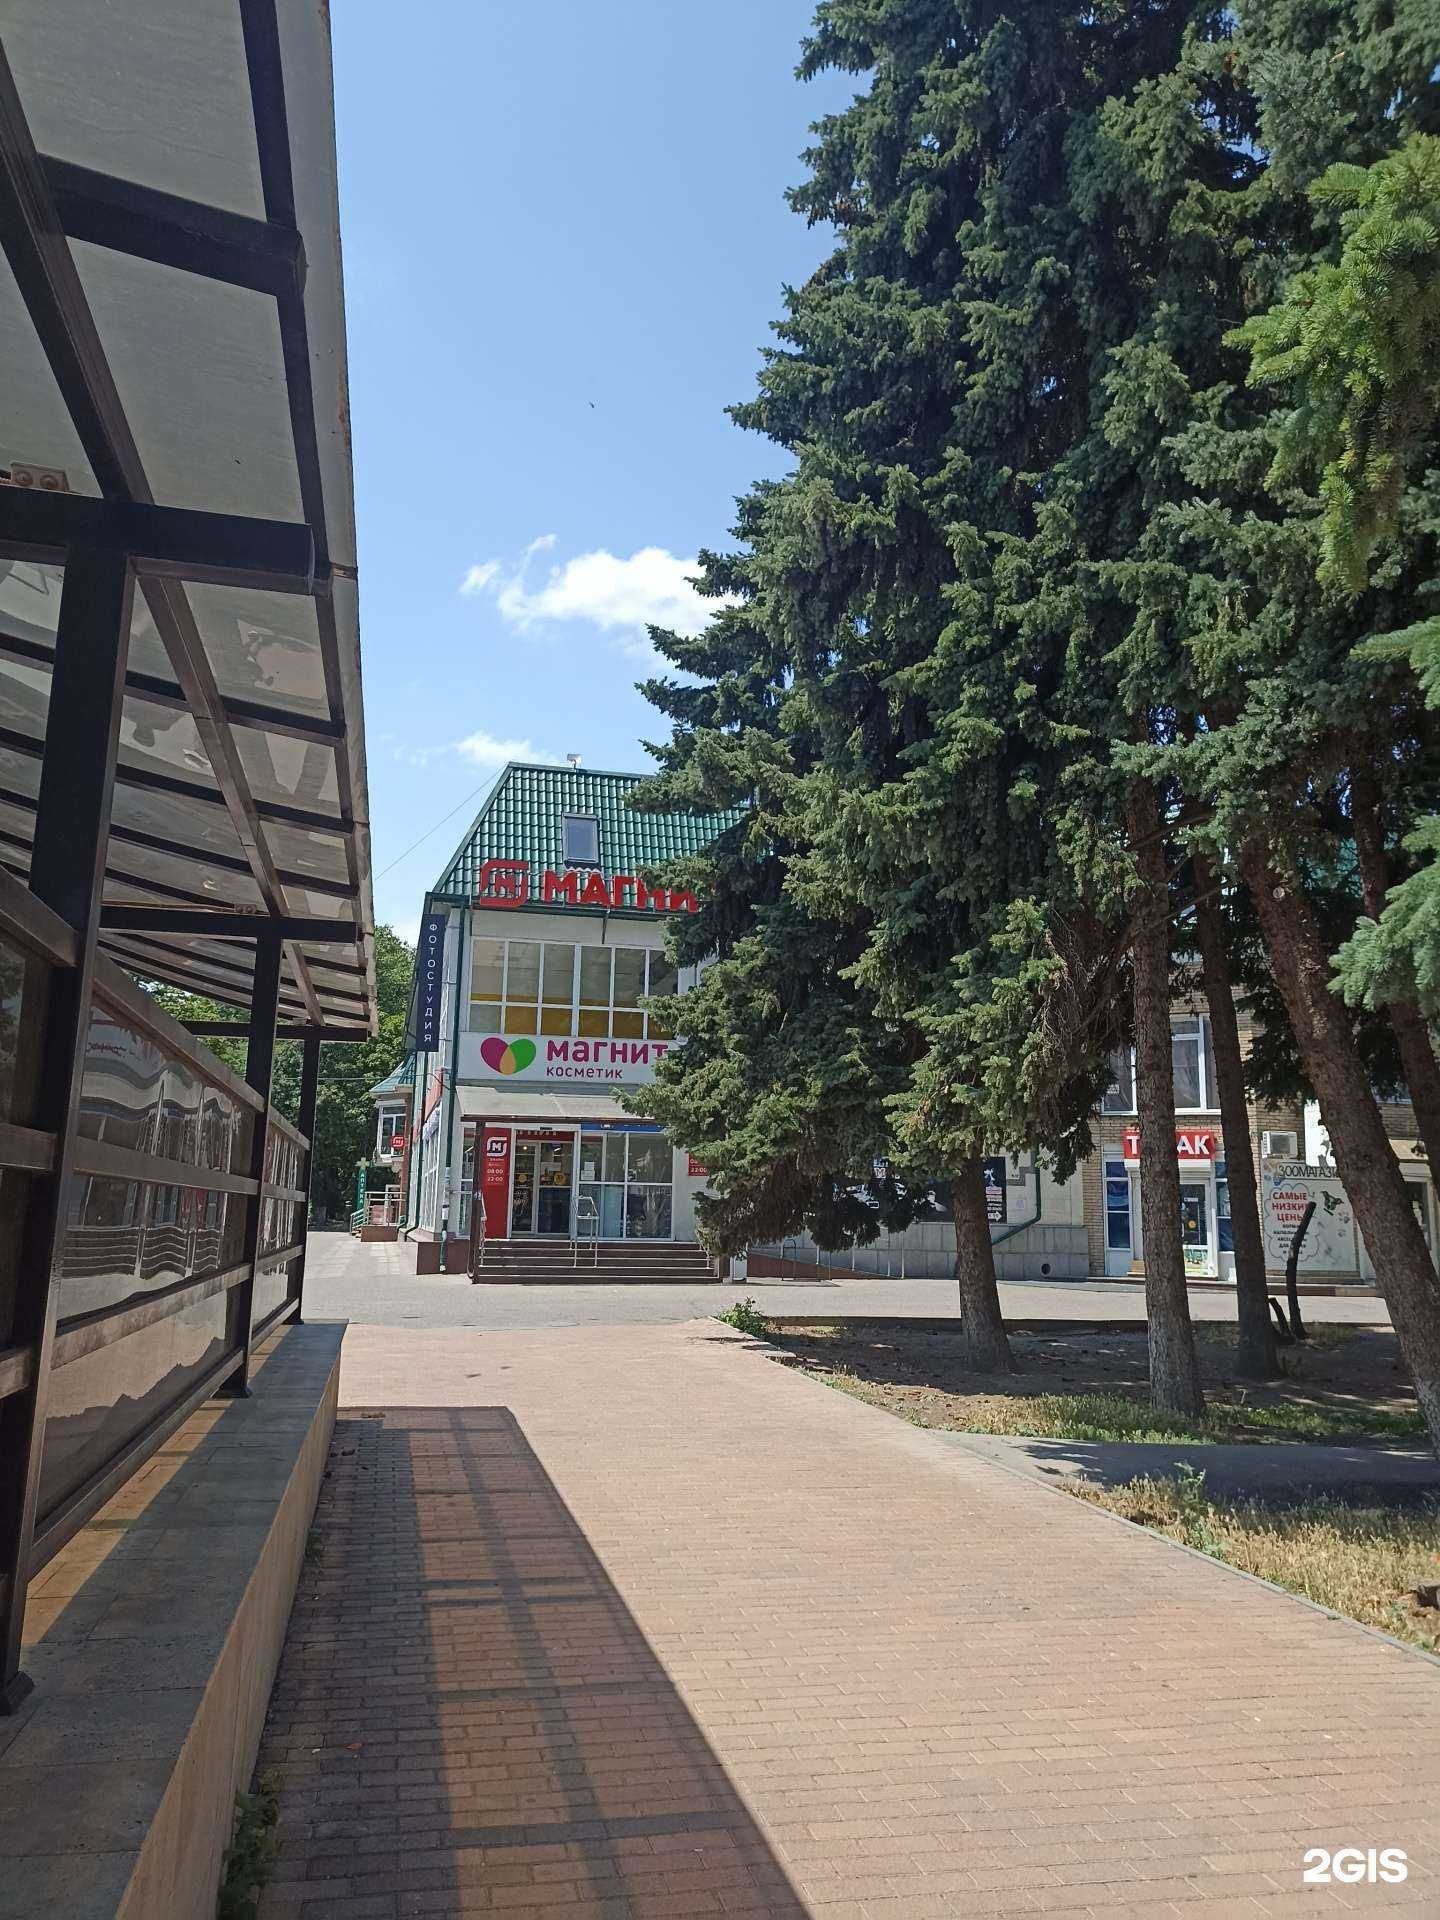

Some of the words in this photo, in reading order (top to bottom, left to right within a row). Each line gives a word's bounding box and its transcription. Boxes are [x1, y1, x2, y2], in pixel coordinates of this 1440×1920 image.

[543, 869, 698, 913] МАГНИ
[424, 923, 438, 1042] ФОТОСТУДИЯ
[546, 1039, 669, 1065] магнит
[546, 1066, 622, 1079] косметик
[1126, 1134, 1209, 1155] ТАК
[1272, 1192, 1308, 1201] САМЫЕ
[1272, 1202, 1306, 1211] НИЗКИ
